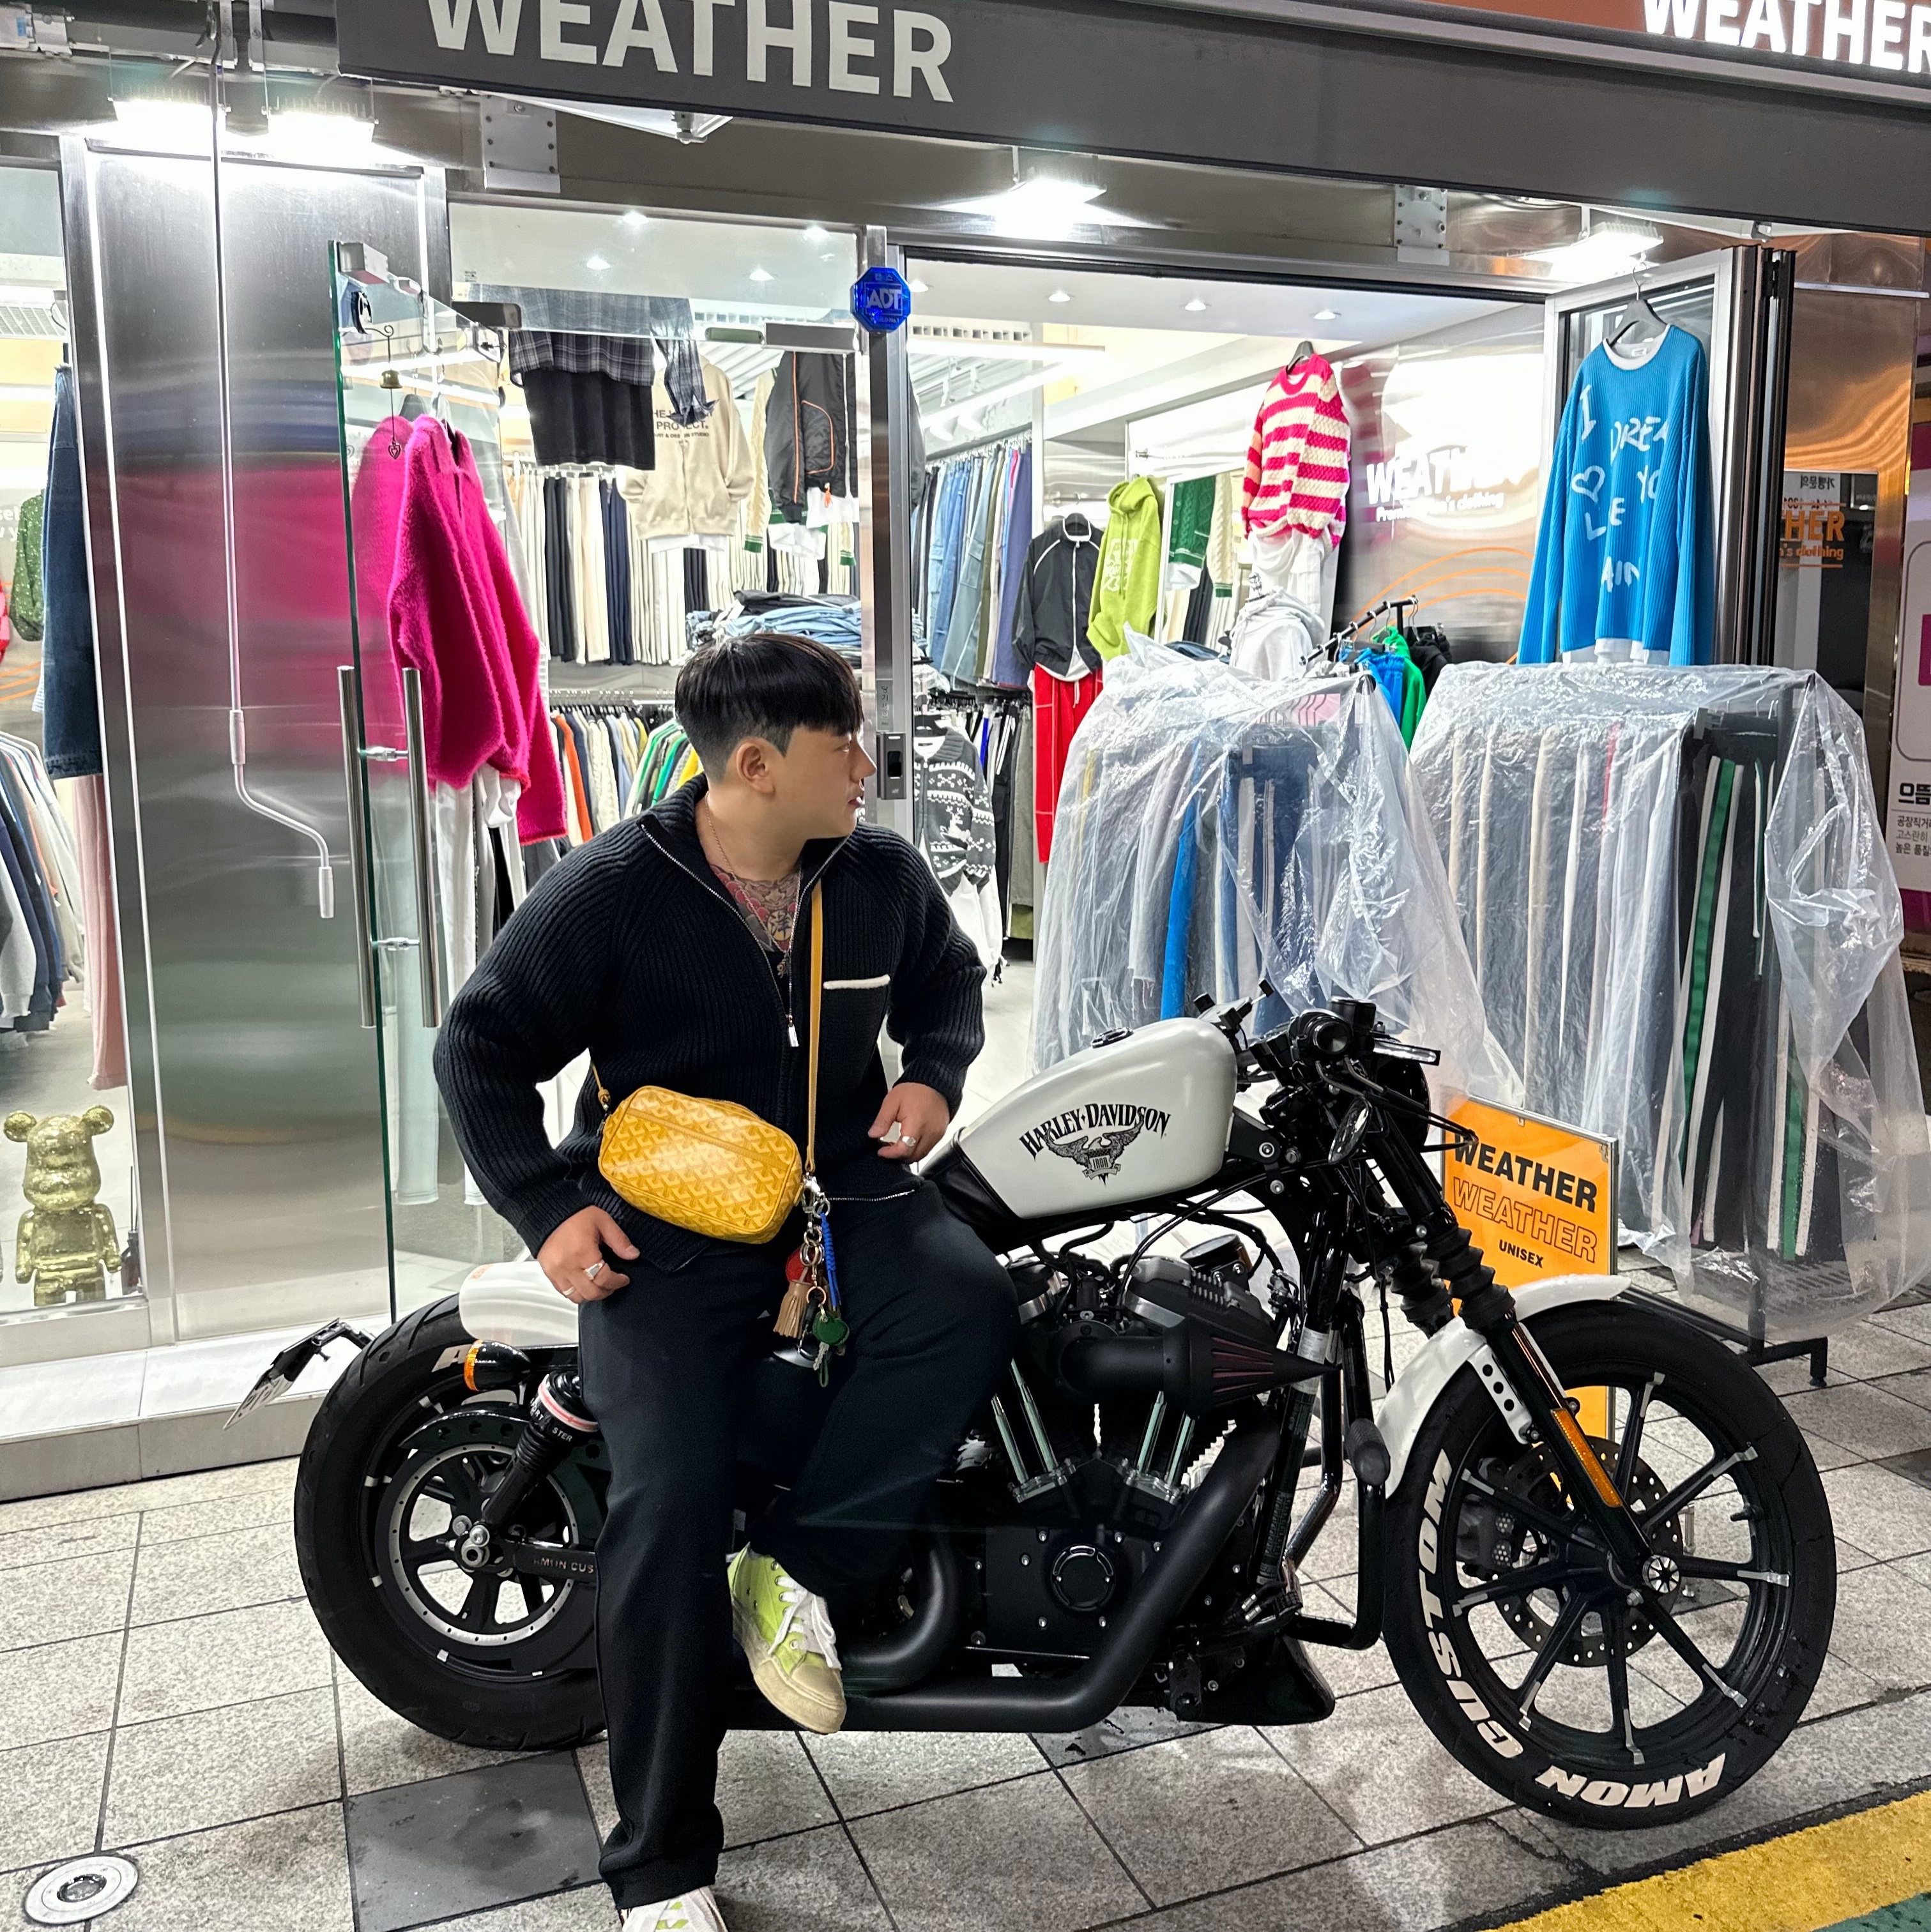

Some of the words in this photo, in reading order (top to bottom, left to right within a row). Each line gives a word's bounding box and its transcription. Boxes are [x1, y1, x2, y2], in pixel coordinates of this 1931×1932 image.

[429, 0, 954, 103] WEATHER
[866, 288, 902, 310] ADT
[1796, 545, 1845, 561] clothing
[1895, 830, 1928, 843] 고스란히
[1897, 815, 1931, 830] 공장직거
[1454, 1133, 1597, 1213] WEATHER
[1453, 1176, 1598, 1264] WEATHER
[1499, 1239, 1544, 1268] UNISEX
[1418, 1448, 1524, 1758] CUSTOM
[1536, 1753, 1726, 1807] AMON
